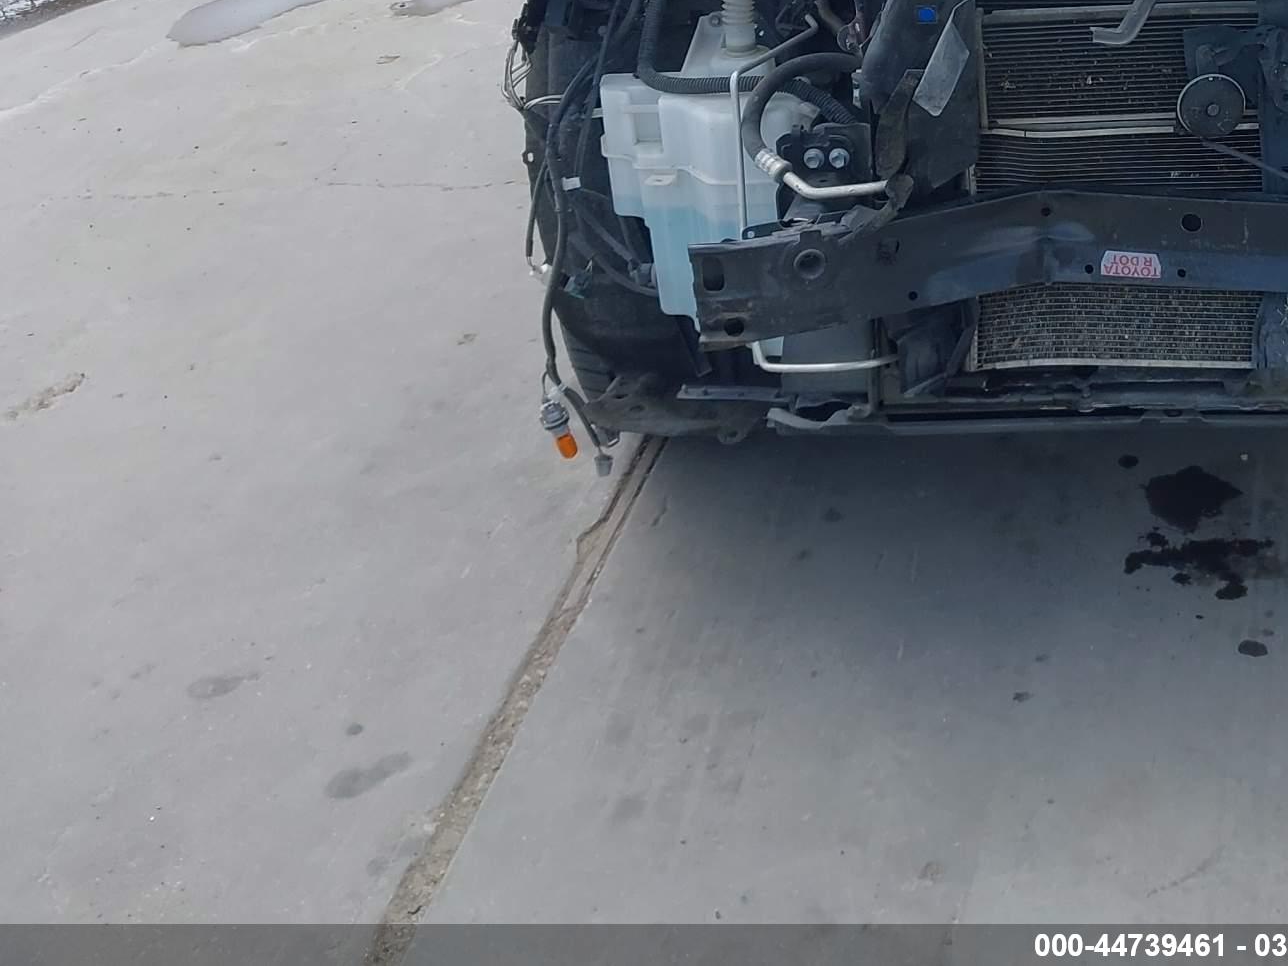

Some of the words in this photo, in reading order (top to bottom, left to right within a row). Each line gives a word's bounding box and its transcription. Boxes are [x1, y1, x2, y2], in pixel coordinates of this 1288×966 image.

[1111, 254, 1140, 266] DOT
[1143, 256, 1153, 267] R
[1103, 264, 1158, 277] TOYOTA
